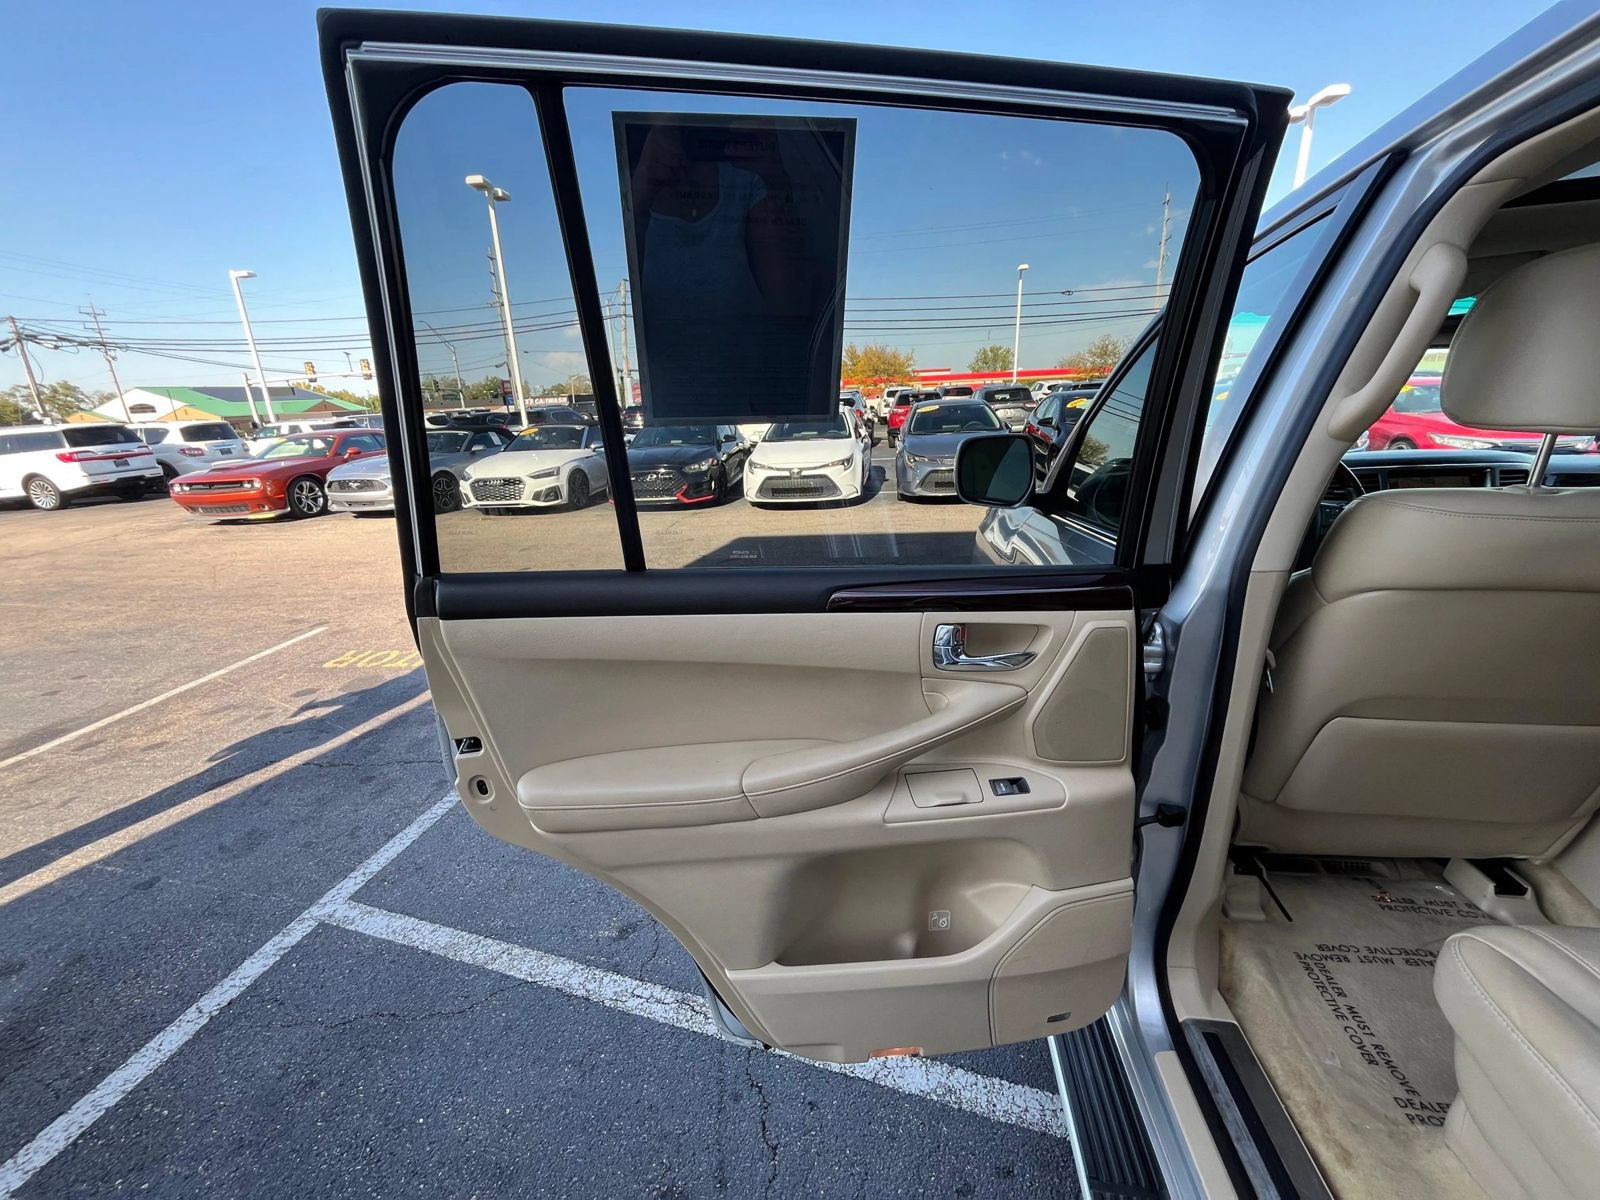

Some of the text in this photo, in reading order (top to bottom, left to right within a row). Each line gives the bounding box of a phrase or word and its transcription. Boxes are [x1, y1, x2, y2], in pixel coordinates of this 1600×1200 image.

[1378, 903, 1454, 917] PROTECTIVE
[1424, 899, 1458, 908] MUST
[1315, 943, 1360, 954] COVER
[1293, 951, 1437, 967] ALER MUST REMOVE
[1299, 960, 1379, 1067] PROTECTIVE COVER
[1314, 961, 1422, 1097] DEALER MUST REMOVE
[1393, 1096, 1452, 1114] DEALE
